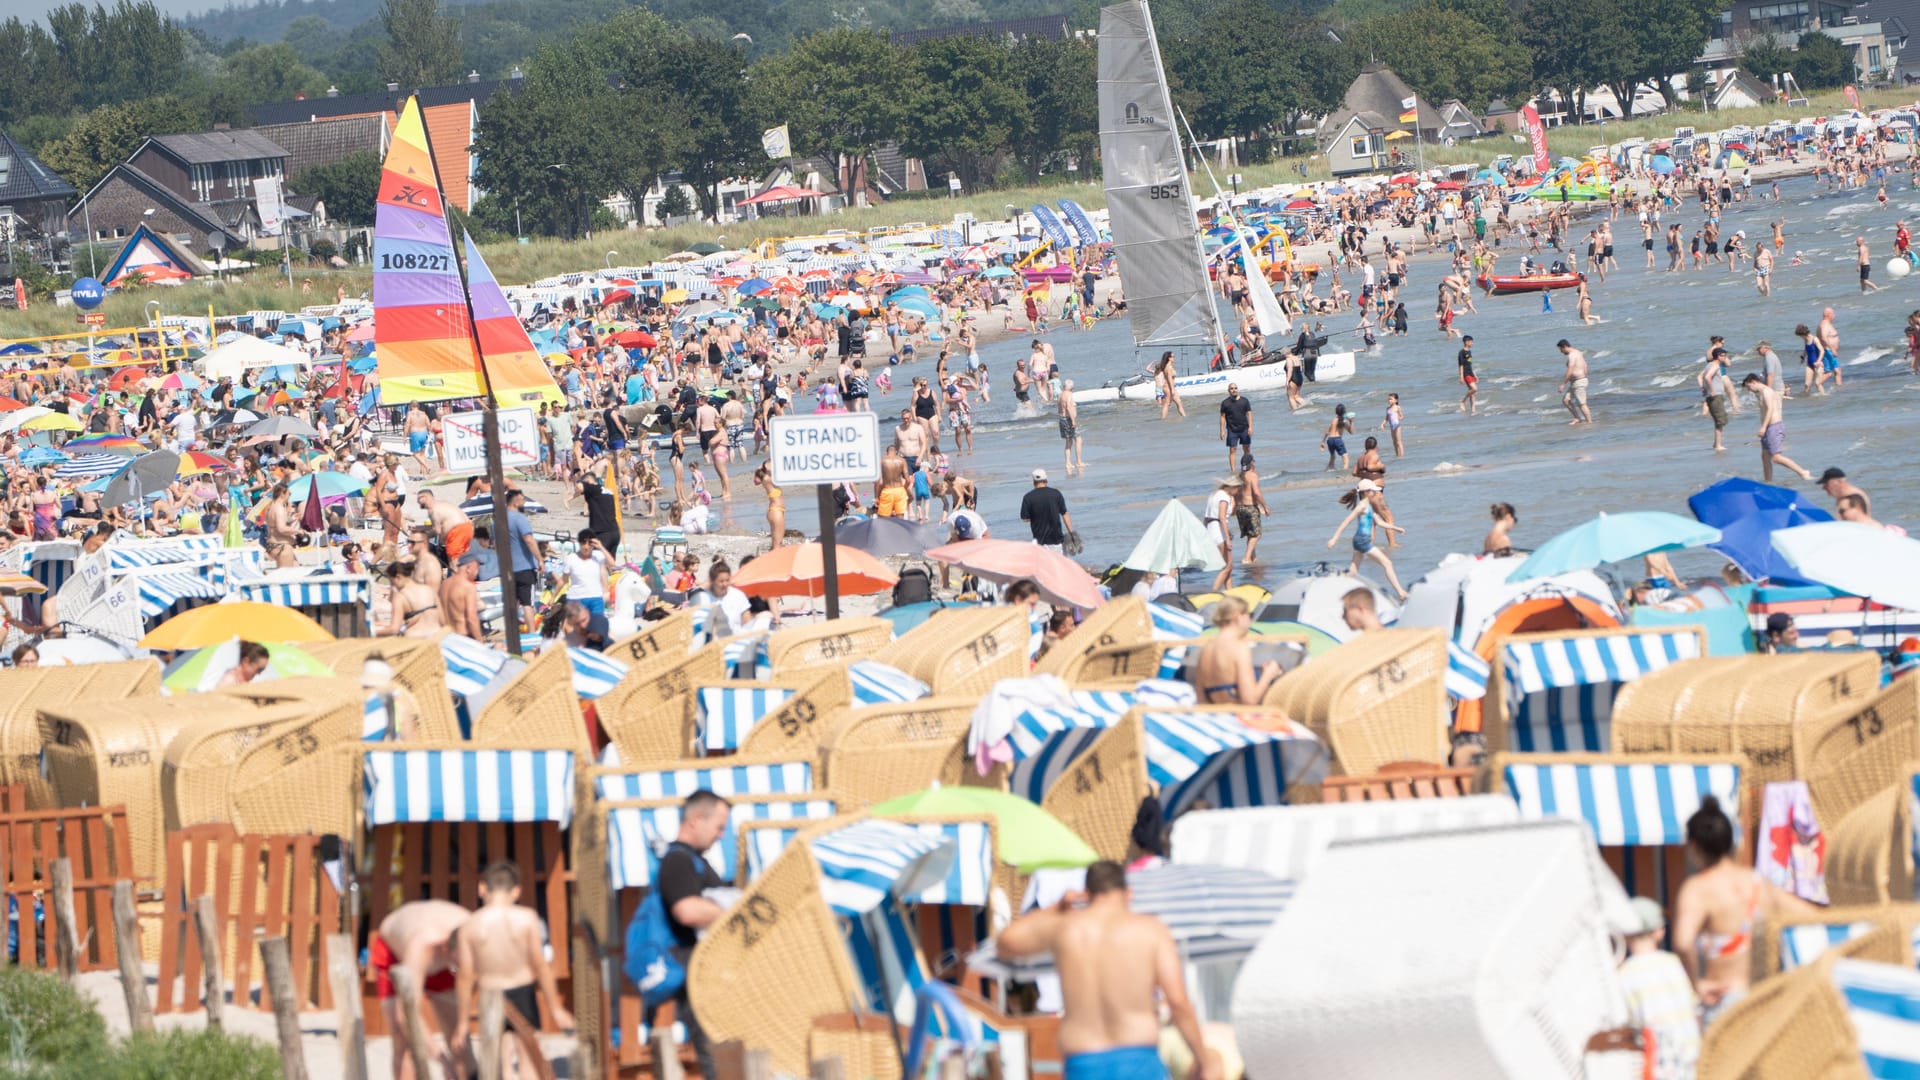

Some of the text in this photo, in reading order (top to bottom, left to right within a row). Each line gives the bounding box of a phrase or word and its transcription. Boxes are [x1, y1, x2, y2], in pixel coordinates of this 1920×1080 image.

[1150, 184, 1179, 200] 963
[381, 252, 449, 271] 108227
[456, 419, 523, 439] STRND-
[784, 425, 863, 447] STRAND-
[783, 451, 868, 471] MUSCHEL
[85, 564, 98, 580] 70
[110, 591, 126, 608] 66
[629, 633, 660, 660] 81
[776, 697, 817, 737] 50
[1845, 705, 1884, 746] 73
[728, 893, 778, 947] 20
